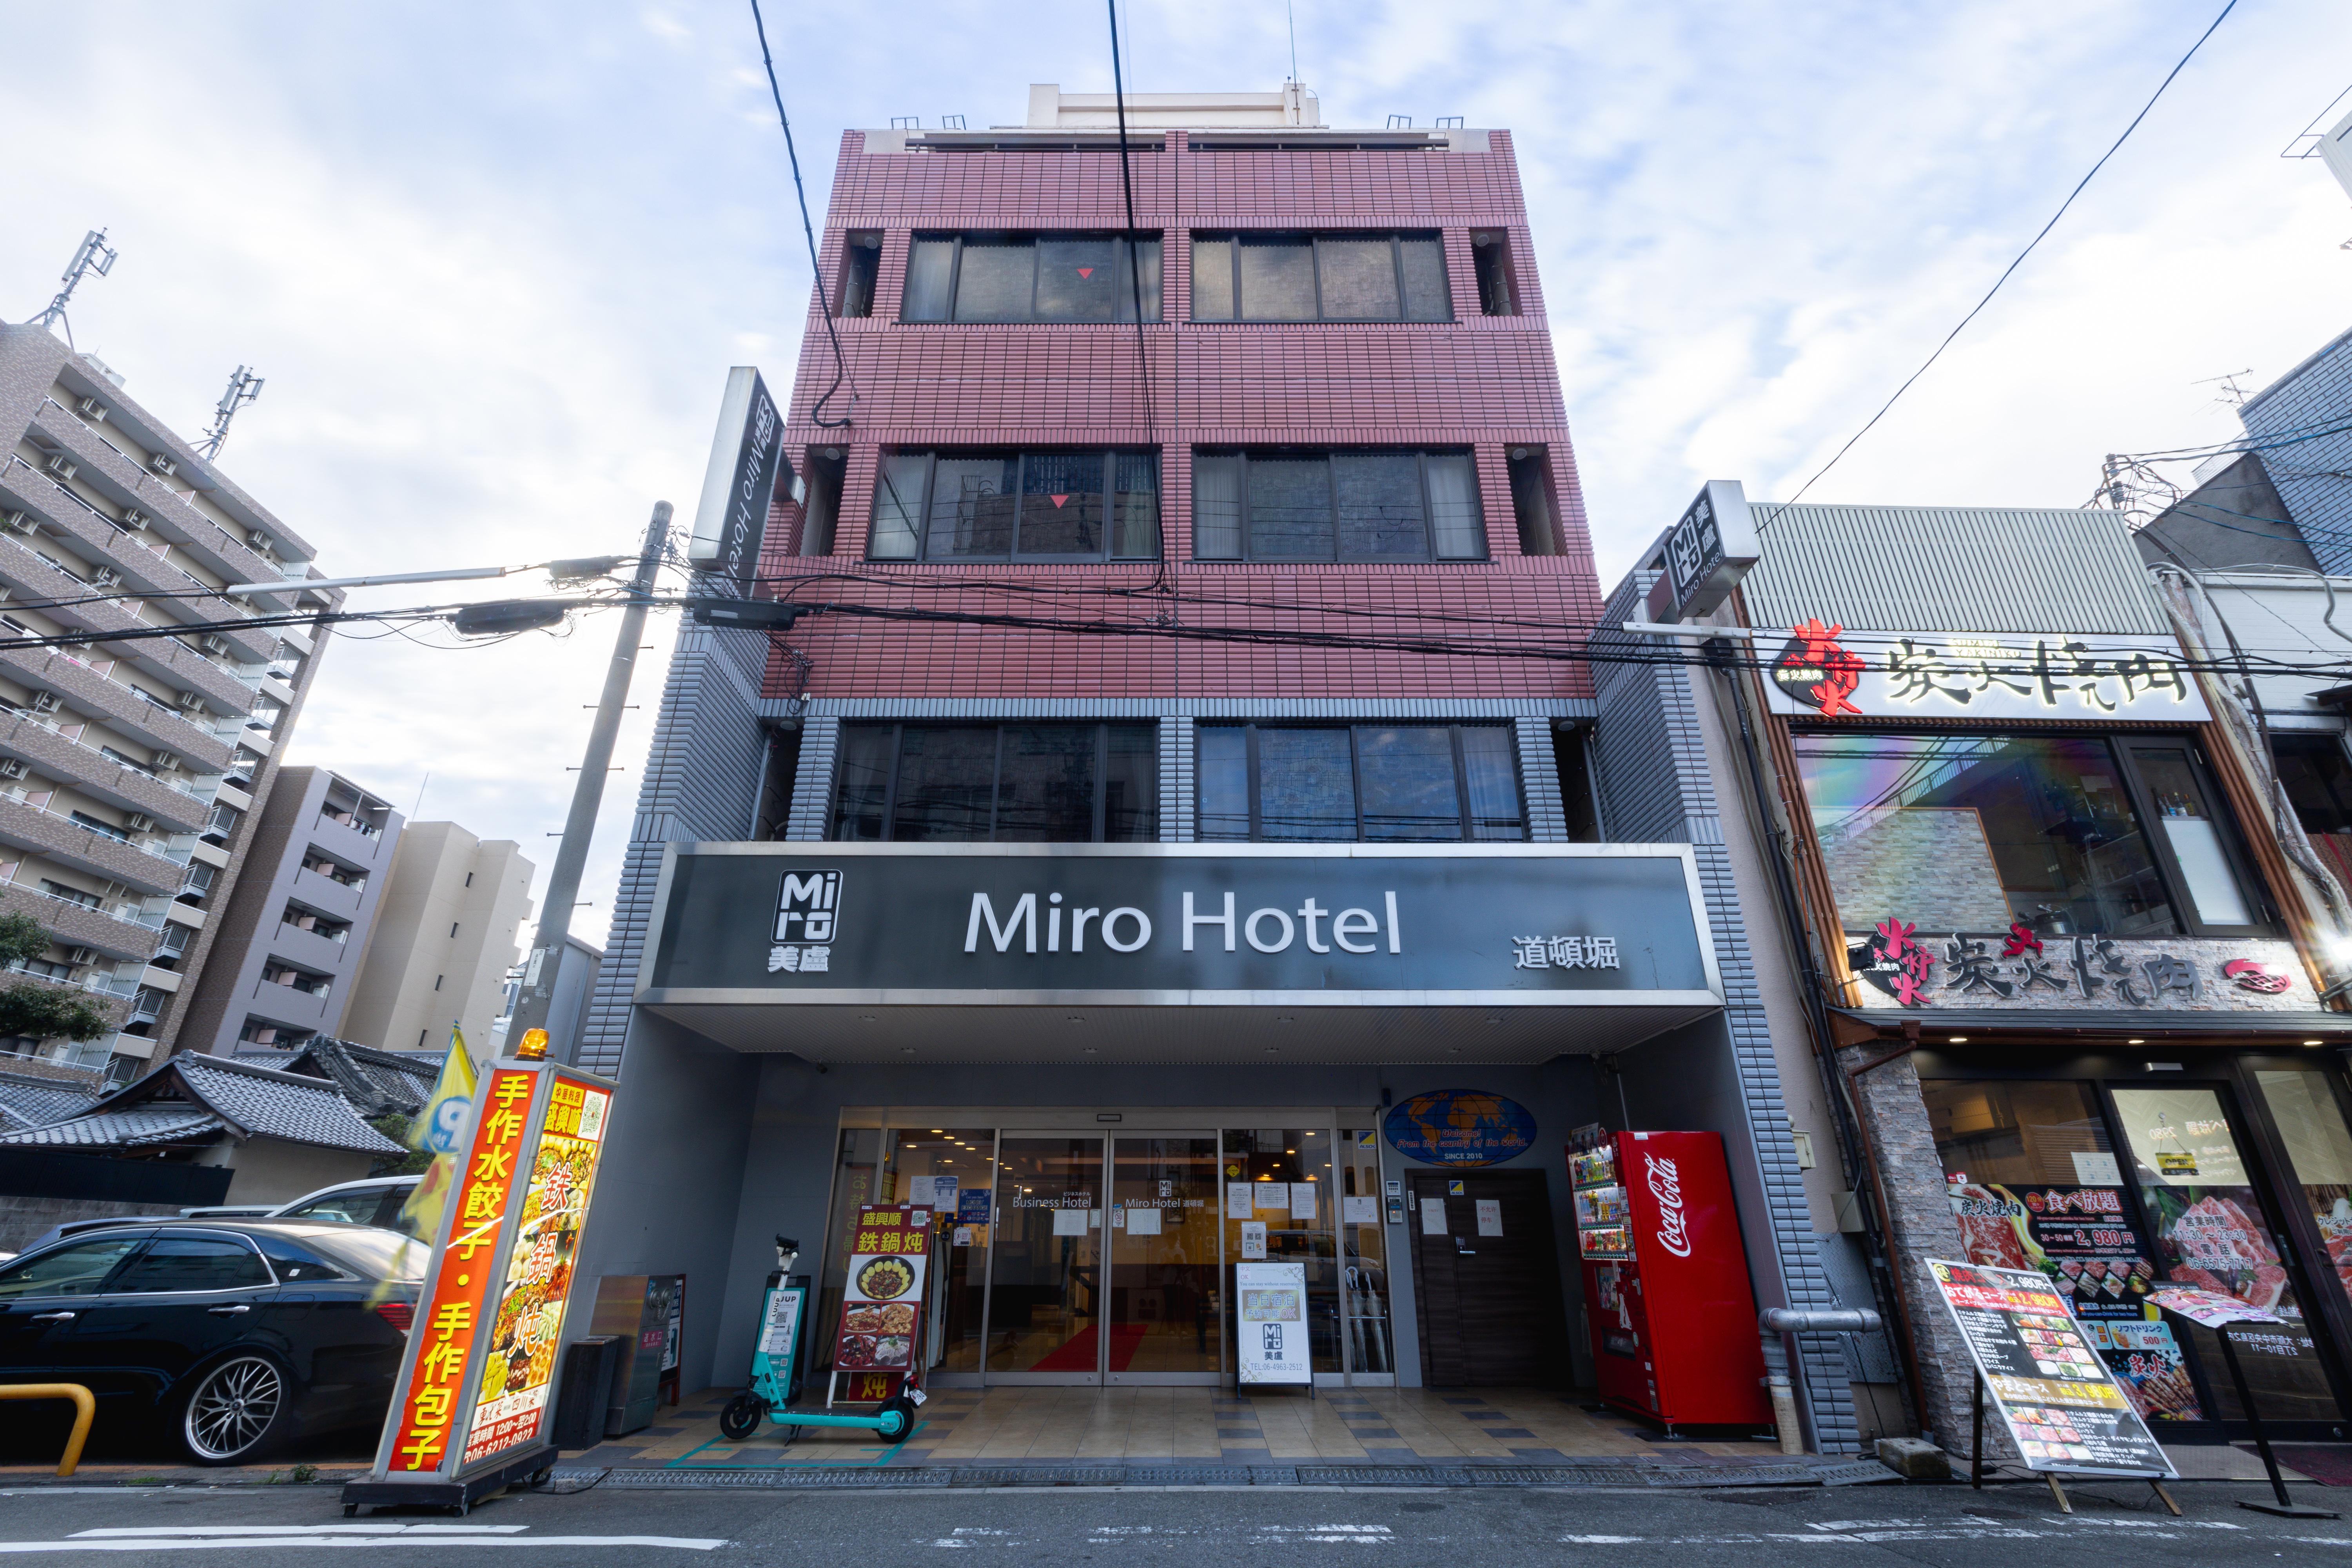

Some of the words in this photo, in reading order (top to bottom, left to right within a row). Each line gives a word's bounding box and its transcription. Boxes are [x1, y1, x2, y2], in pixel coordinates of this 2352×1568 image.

[744, 438, 763, 500] Miro
[728, 501, 751, 584] Hotel
[1681, 579, 1699, 606] Miro
[1700, 545, 1722, 581] Hotel
[1888, 634, 2187, 715] 炭火焼肉
[964, 892, 1152, 953] Miro
[1182, 891, 1401, 955] Hotel
[1512, 935, 1620, 970] 道頓堀
[1944, 933, 2202, 1005] 炭火焼肉
[555, 1086, 581, 1103] 中華料理
[1397, 1139, 1419, 1148] From
[1423, 1139, 1435, 1147] the
[1439, 1140, 1470, 1149] country
[1473, 1139, 1483, 1148] of
[1486, 1138, 1499, 1147] the
[1502, 1138, 1528, 1147] world.
[1442, 1129, 1481, 1137] Welcome!
[1013, 1197, 1059, 1207] Business
[1062, 1196, 1091, 1207] Hotel
[1125, 1198, 1149, 1208] Miro
[1152, 1198, 1180, 1208] Hotel
[1643, 1151, 1691, 1257] Coca-Cola
[2045, 1190, 2121, 1212] 食べ放題
[2183, 1216, 2227, 1227] 営業時間
[857, 1231, 924, 1252] 鉄鍋炖
[2173, 1230, 2202, 1240] 11:30
[2217, 1230, 2247, 1240] 23:30
[2187, 1258, 2253, 1269] 06-6575-7717
[1247, 1293, 1295, 1307] 当日宿泊
[1942, 1284, 2008, 1303] おてがるコース
[2017, 1293, 2060, 1308] 2,980円
[772, 1298, 780, 1317] LUUP
[2115, 1324, 2163, 1333] ソフトドリンク
[2129, 1354, 2169, 1378] 炭火
[1989, 1377, 2051, 1394] やまとコース
[2070, 1383, 2118, 1399] 3,980円
